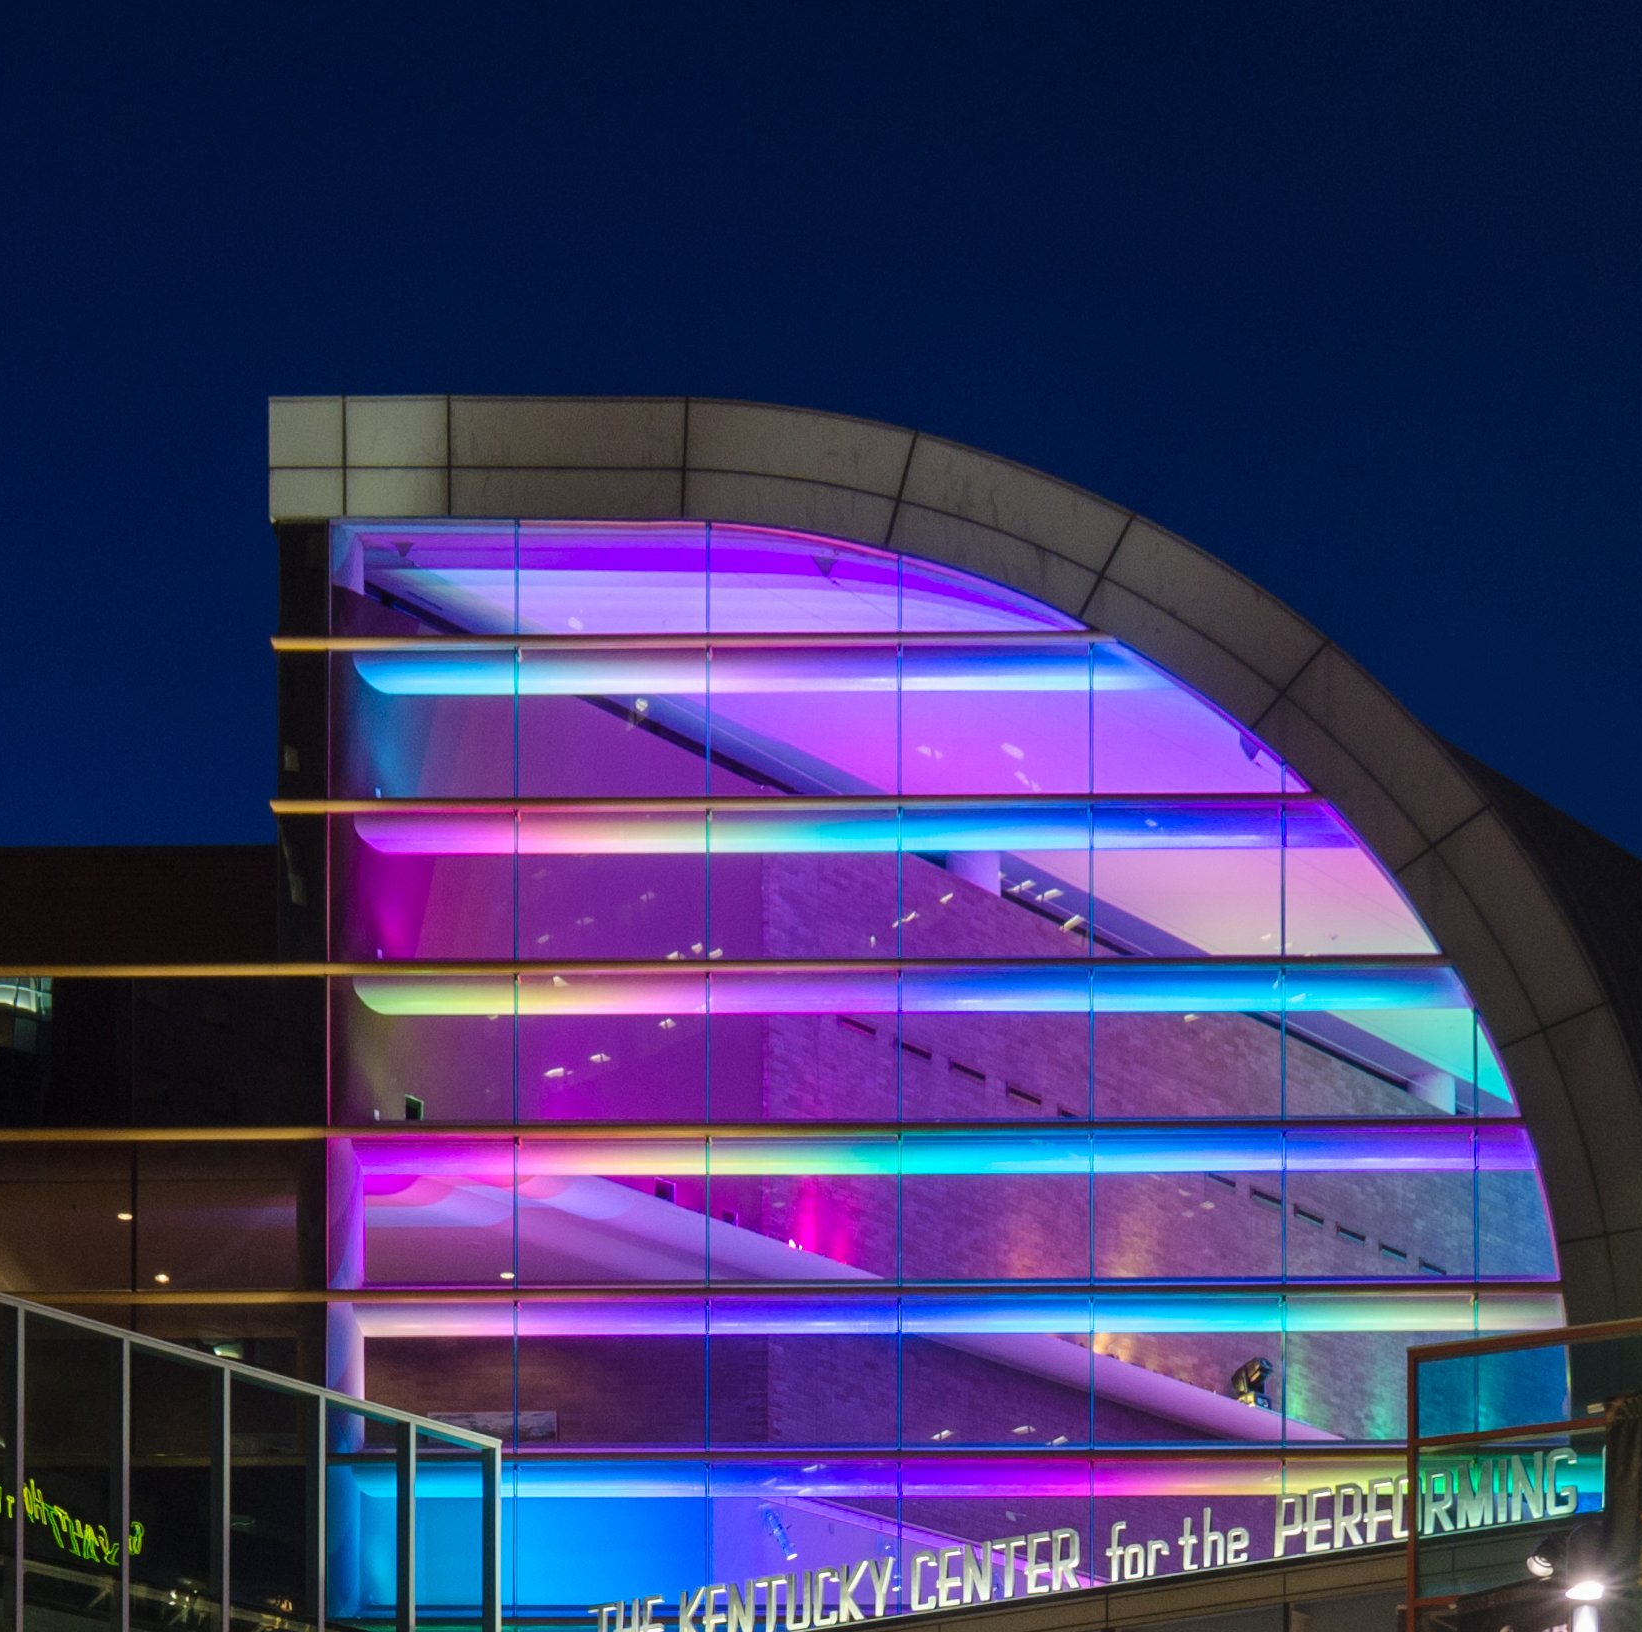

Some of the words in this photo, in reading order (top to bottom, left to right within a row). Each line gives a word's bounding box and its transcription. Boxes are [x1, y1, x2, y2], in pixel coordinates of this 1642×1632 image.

[910, 1527, 1080, 1613] CENTER
[1106, 1521, 1170, 1583] for
[1178, 1507, 1250, 1571] the
[1274, 1447, 1578, 1558] PERFORMING
